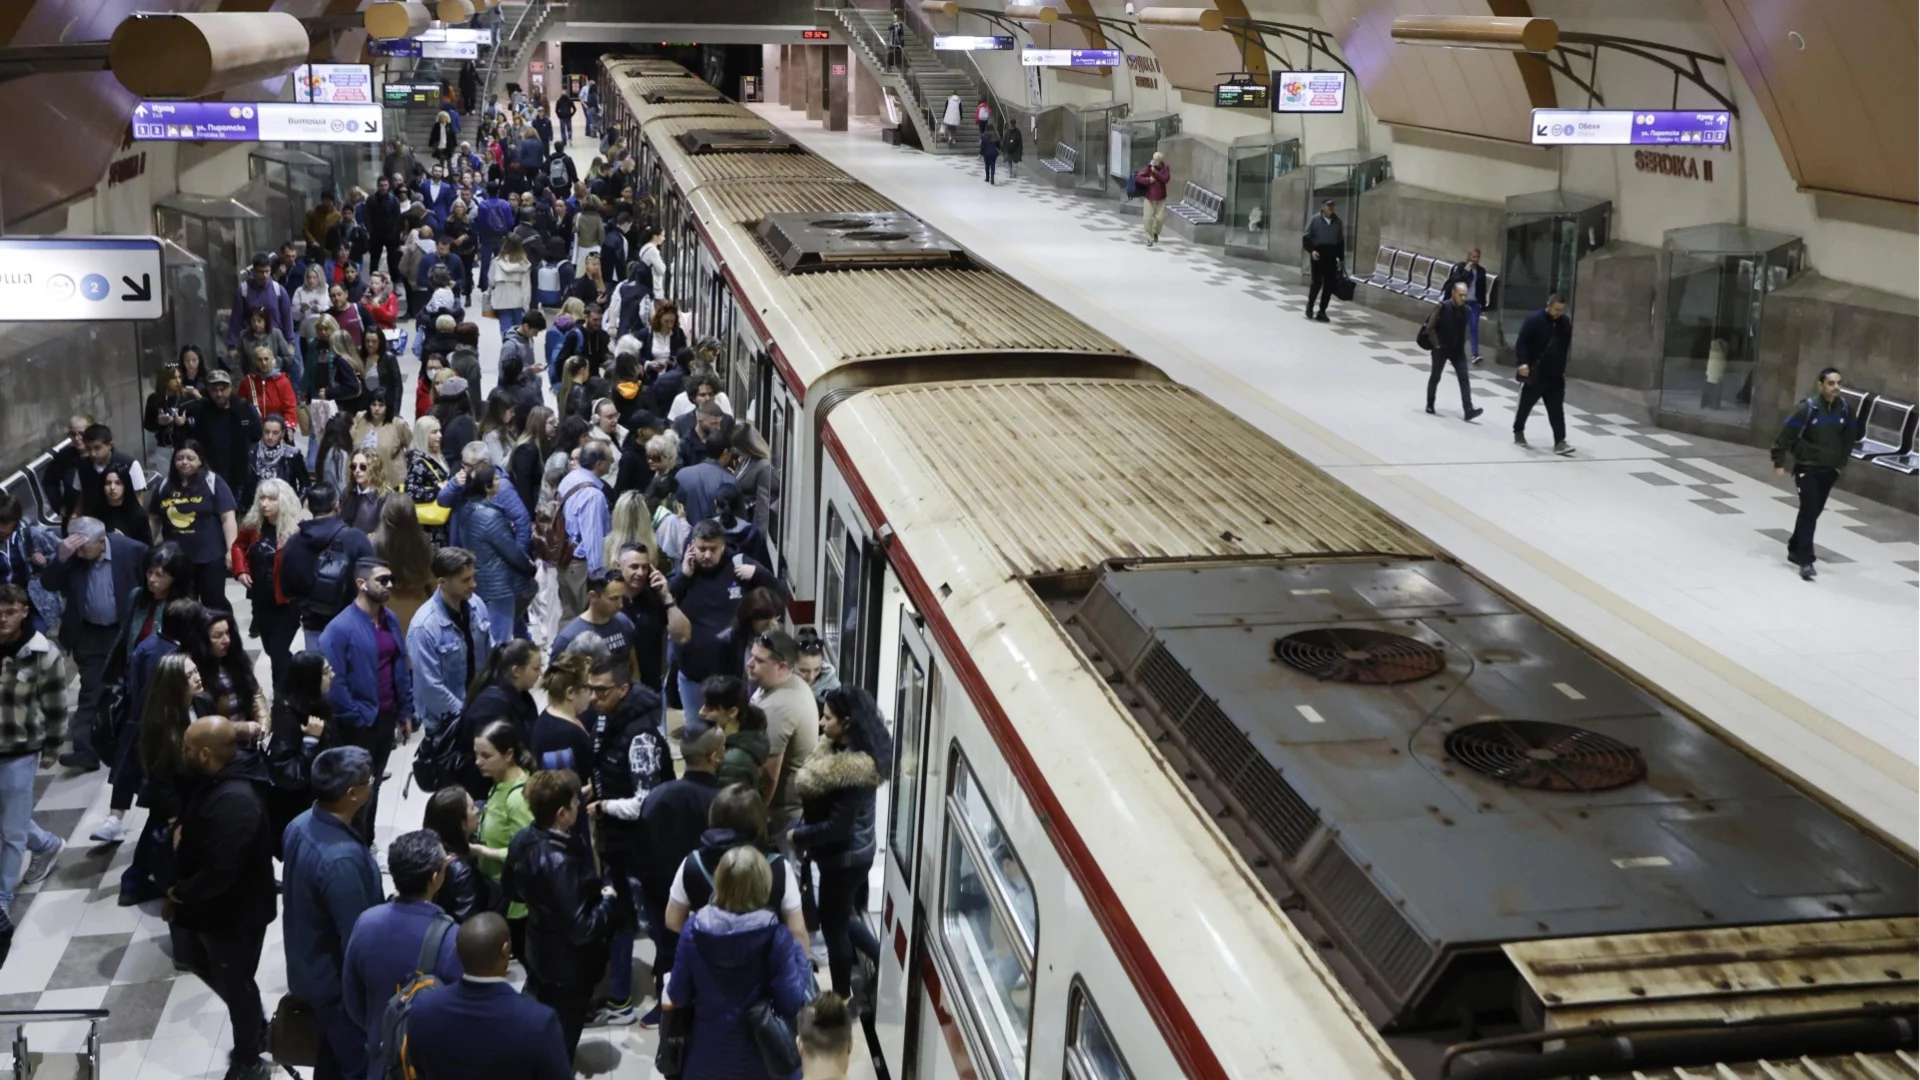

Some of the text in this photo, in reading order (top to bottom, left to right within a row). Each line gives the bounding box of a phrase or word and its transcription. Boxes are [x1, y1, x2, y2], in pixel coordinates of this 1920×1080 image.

[152, 104, 175, 114] Изход
[288, 117, 327, 125] Витоша
[208, 124, 246, 133] Пиротска
[1634, 150, 1713, 182] SERDIKA II
[90, 282, 99, 293] 2
